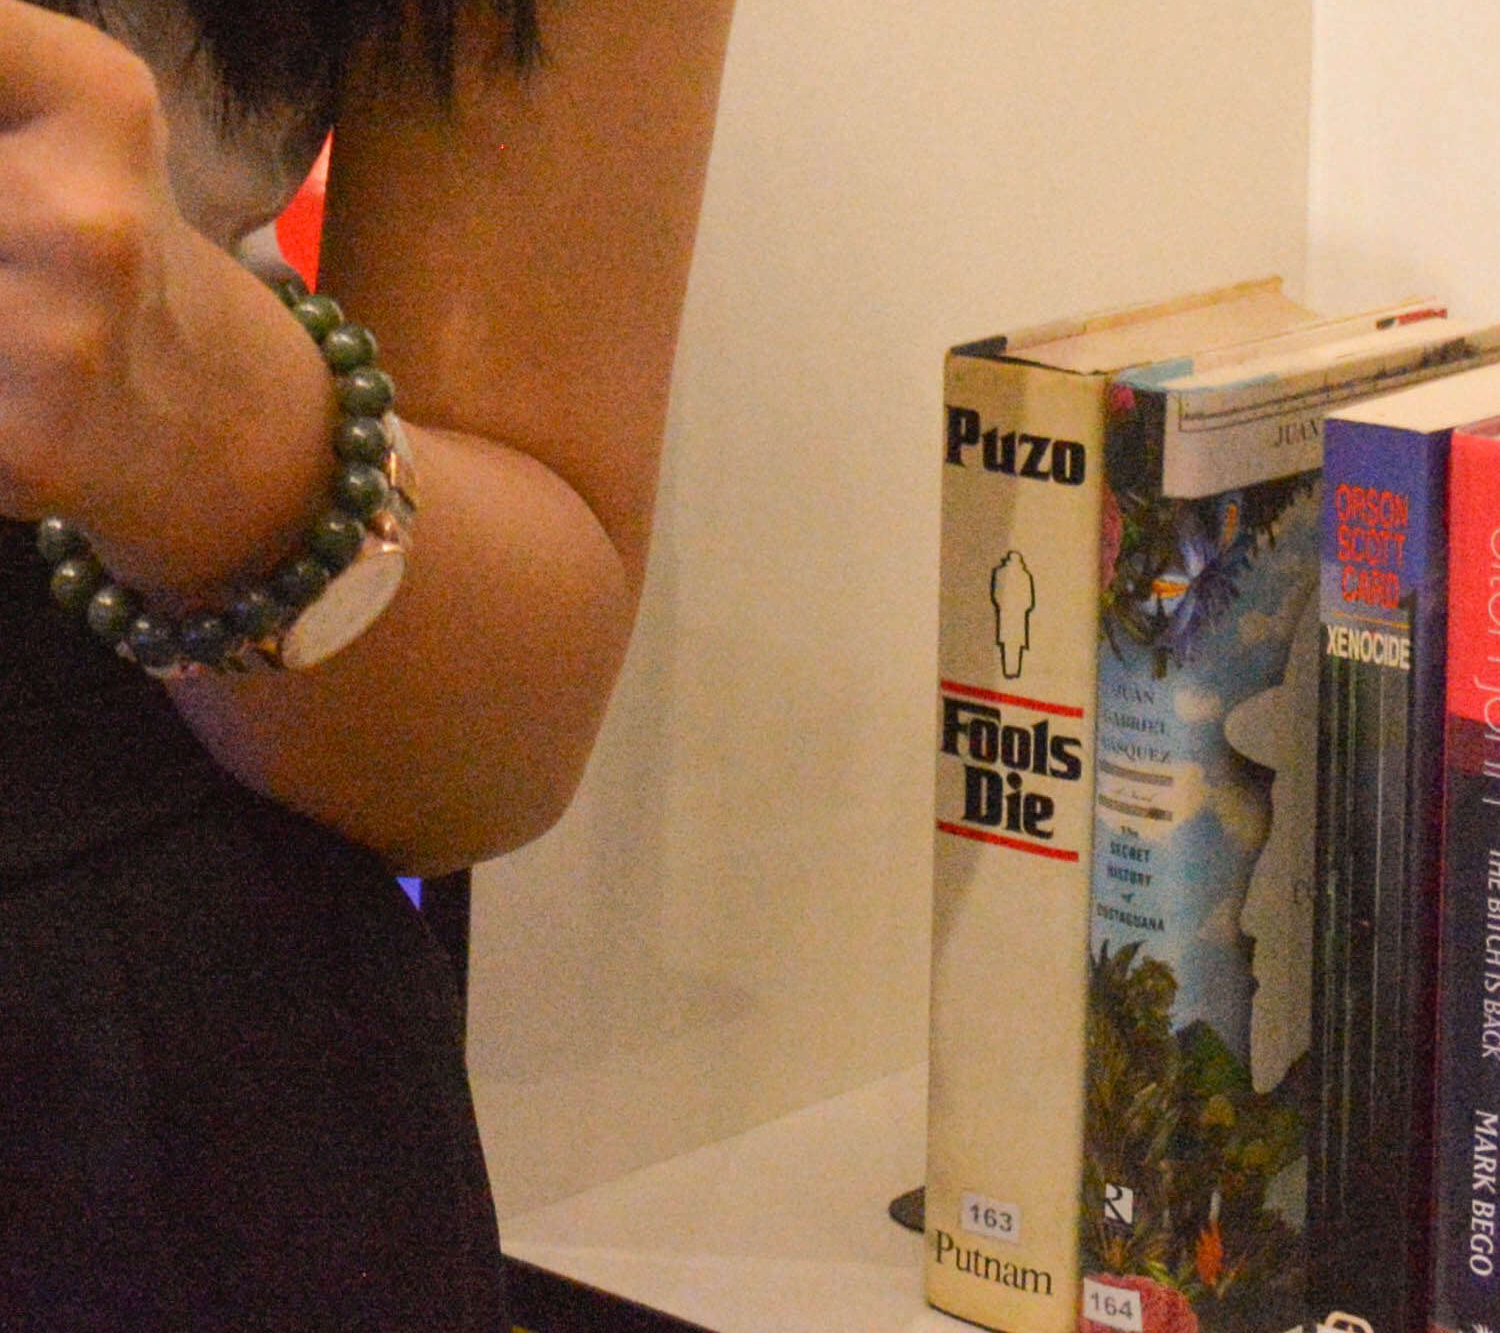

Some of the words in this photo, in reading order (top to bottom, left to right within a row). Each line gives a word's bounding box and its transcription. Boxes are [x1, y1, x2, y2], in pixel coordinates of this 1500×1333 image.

[944, 403, 1087, 487] Puzo
[1335, 483, 1410, 528] ORSON
[1337, 524, 1406, 568] SCOTT
[1340, 564, 1401, 609] CARD
[1326, 624, 1411, 671] XENOCIDE
[941, 695, 1084, 782] Fools
[961, 762, 1056, 839] Die
[1110, 840, 1152, 864] SECRET
[1106, 864, 1154, 888] HISTORY
[1472, 1108, 1500, 1196] MARK
[967, 1201, 1014, 1233] 163
[1468, 1200, 1496, 1278] BEGO
[934, 1228, 1054, 1298] Putnam
[1089, 1295, 1134, 1321] 164
